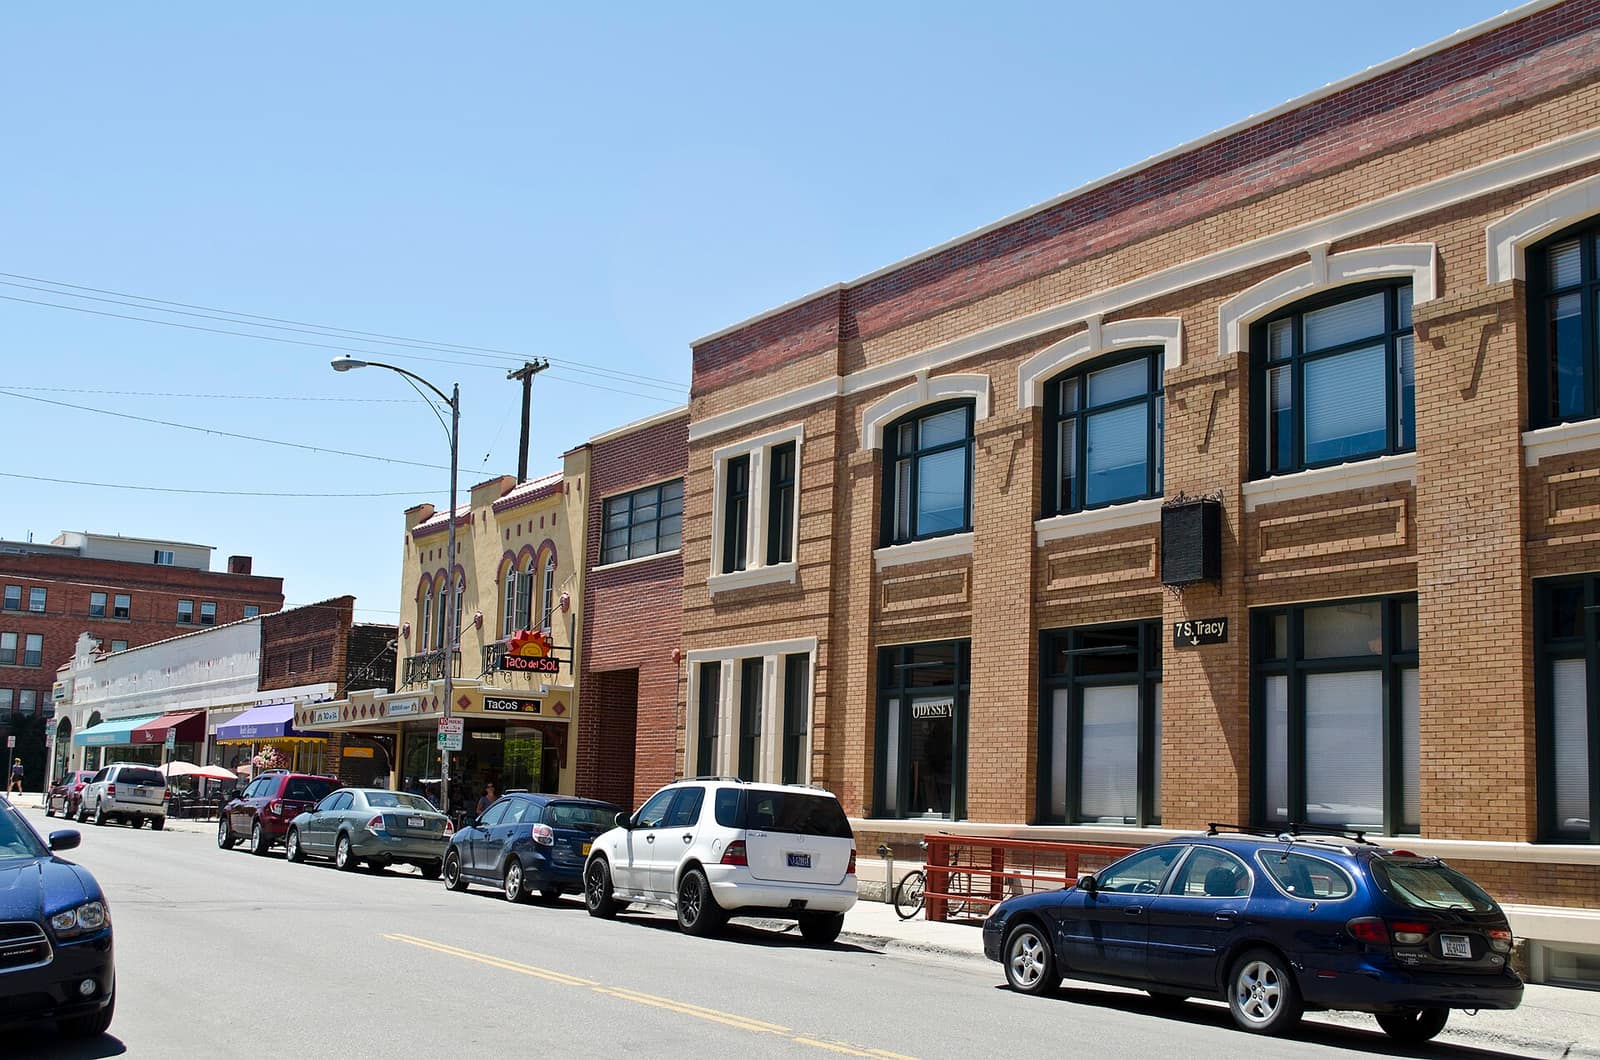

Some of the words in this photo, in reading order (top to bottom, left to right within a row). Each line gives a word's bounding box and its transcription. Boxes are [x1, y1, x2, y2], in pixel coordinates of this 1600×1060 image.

[1176, 623, 1182, 637] 7
[1195, 621, 1225, 637] Tracy
[912, 703, 953, 719] ODYSSEY
